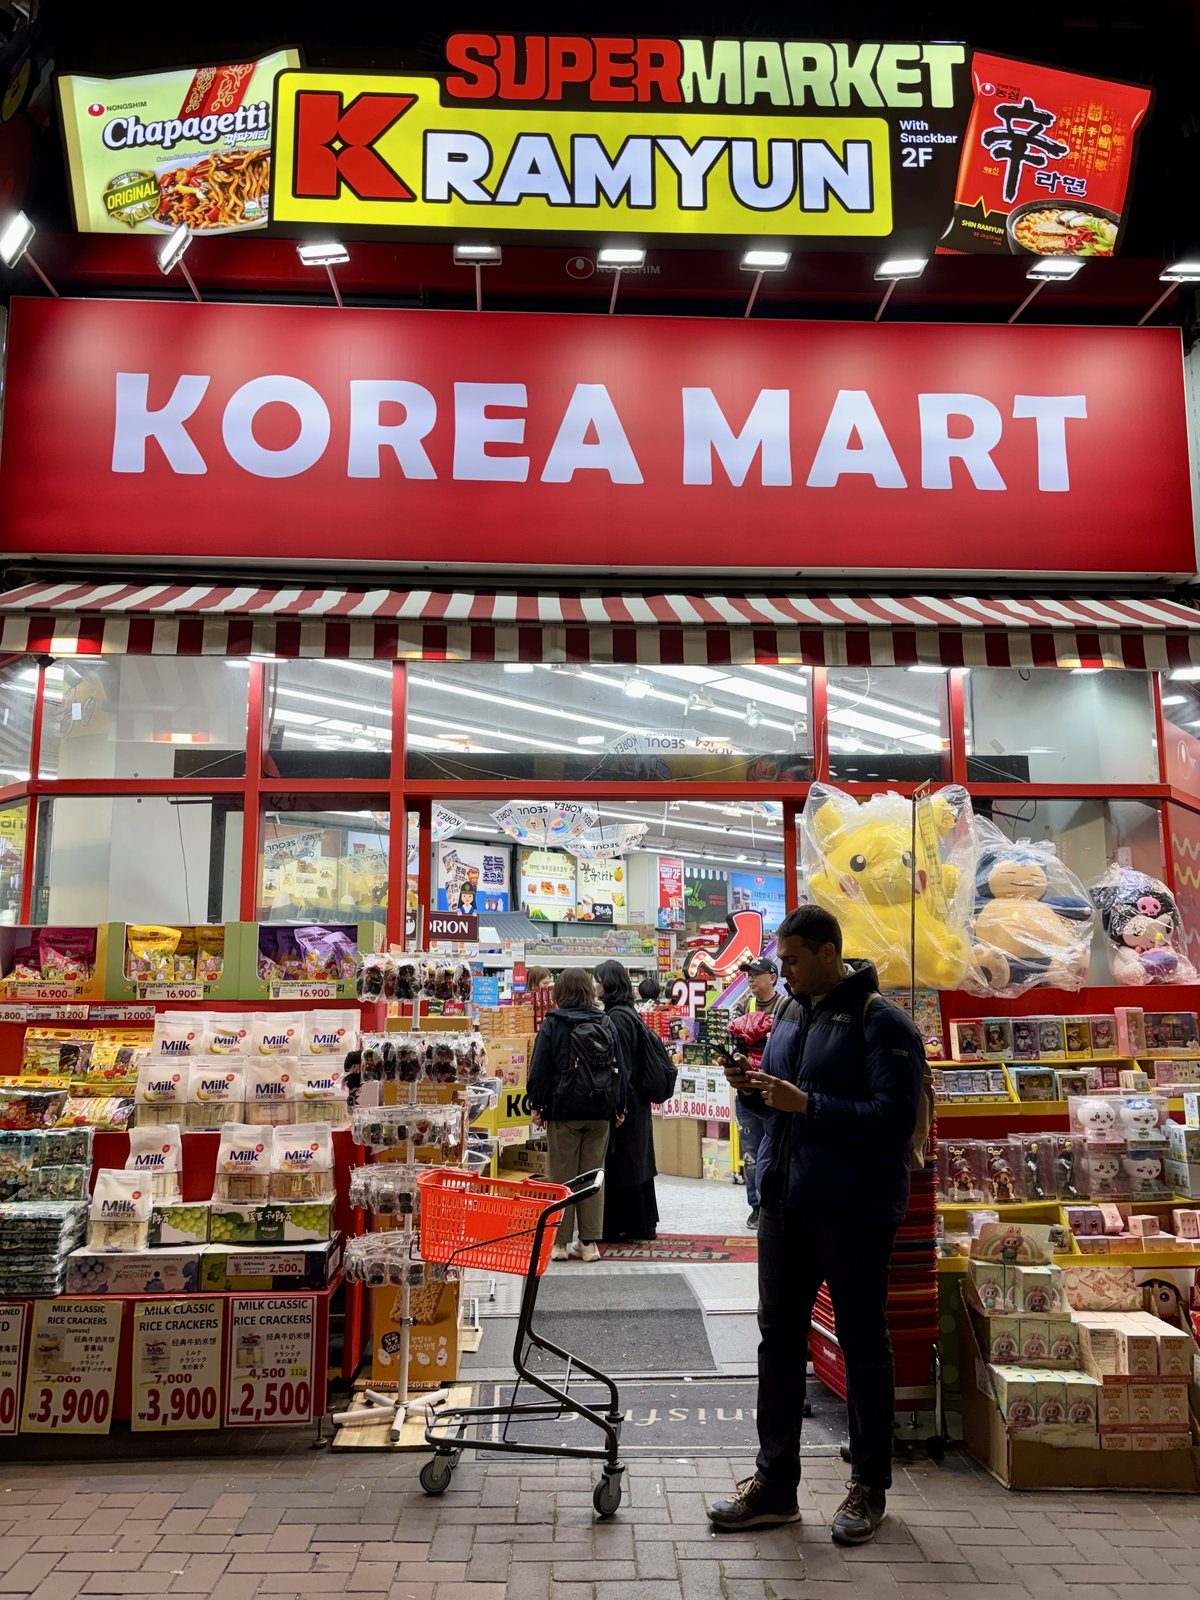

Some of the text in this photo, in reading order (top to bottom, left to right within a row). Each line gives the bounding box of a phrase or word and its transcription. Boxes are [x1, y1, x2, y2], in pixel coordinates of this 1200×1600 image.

[445, 33, 965, 109] SUPERMARKET
[996, 89, 1019, 101] 농심
[106, 101, 148, 112] NONGSHIM
[103, 101, 269, 149] Chapagetti
[899, 119, 929, 131] With
[224, 129, 268, 147] 짜파게티
[900, 132, 958, 146] Snackbar
[981, 97, 1070, 204] 辛
[901, 148, 933, 170] 2F
[1034, 170, 1087, 197] 라면
[107, 185, 158, 210] ORIGINAL
[961, 219, 1005, 235] SHIN RAMYUN
[110, 371, 1088, 492] KOREA MART
[612, 735, 639, 753] KOREA
[644, 737, 686, 749] SEOUL
[496, 806, 514, 822] KOREA
[517, 805, 549, 816] SEOUL
[554, 802, 584, 814] KOREA
[436, 810, 463, 827] KOREA
[266, 839, 297, 851] SEOUL
[591, 842, 620, 850] SEOUL
[580, 862, 614, 883] 꿀유자차
[672, 869, 681, 879] 2F
[688, 898, 707, 910] bibigo
[428, 920, 469, 935] RION
[36, 989, 68, 998] 16,900
[166, 990, 197, 999] 16,900
[299, 989, 330, 998] 16,900
[673, 981, 706, 1019] 2F
[263, 1035, 290, 1045] Milk
[313, 1034, 341, 1044] Milk
[161, 1040, 191, 1051] Milk
[148, 1081, 176, 1091] Milk
[201, 1080, 230, 1090] Milk
[255, 1083, 286, 1094] Milk
[307, 1079, 335, 1089] Milk
[708, 1104, 730, 1118] 6,800
[135, 1154, 166, 1165] Milk
[229, 1150, 260, 1161] Milk
[284, 1149, 314, 1160] Milk
[101, 1199, 136, 1212] Milk
[603, 1248, 731, 1261] MARKET
[269, 1263, 298, 1274] 2,500
[52, 1305, 106, 1314] MILK CLASSIC
[144, 1303, 215, 1316] MILK CLASSIC
[238, 1300, 308, 1311] MILK CLASSIC
[47, 1316, 108, 1325] RICE CRACKERS
[139, 1318, 218, 1331] RICE CRACKERS
[233, 1314, 312, 1326] RICE CRACKERS
[73, 1336, 115, 1344] 经典牛奶米饼
[172, 1337, 217, 1347] 经典牛奶米饼
[265, 1332, 310, 1341] 经典牛奶米饼
[179, 1356, 207, 1364] クラシック
[43, 1375, 82, 1384] 7,000
[154, 1373, 193, 1386] 7,000
[248, 1368, 308, 1380] 4,500 112g
[137, 1386, 217, 1426] ₩3,900
[231, 1381, 311, 1421] ₩2,500
[28, 1388, 110, 1428] ₩3,900
